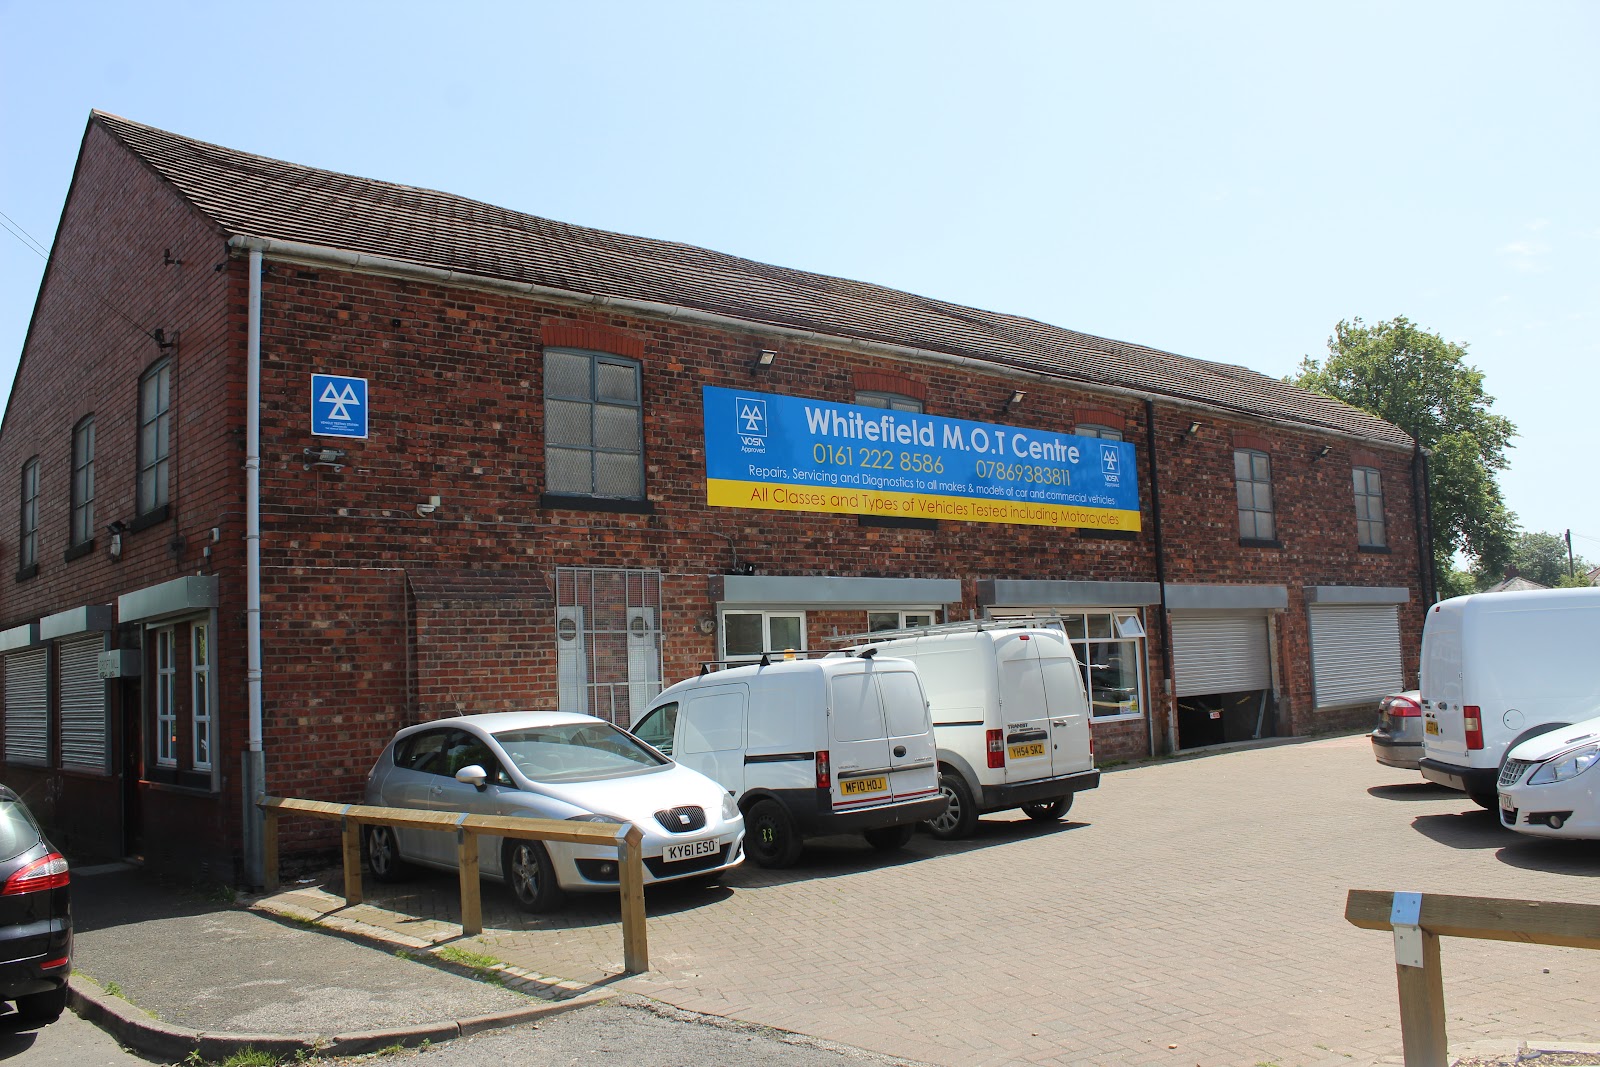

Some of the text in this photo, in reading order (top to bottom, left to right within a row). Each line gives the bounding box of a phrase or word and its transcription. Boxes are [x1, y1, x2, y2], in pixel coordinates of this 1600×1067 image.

[741, 436, 765, 447] VOSA
[804, 406, 1080, 464] Whitefield M.O.T Centre
[741, 446, 766, 454] Approved
[813, 443, 944, 474] 0161 222 8586
[748, 464, 1116, 505] Repairs, Servicing and Diagnostics to all makes & models of car and commercial vehicles
[976, 459, 1071, 487] 07869383811
[750, 487, 1120, 526] All Classes and Types of Vehicles Tested including Motorcycles
[845, 779, 883, 793] MF10 HOJ
[669, 840, 715, 859] KY61 ESO
